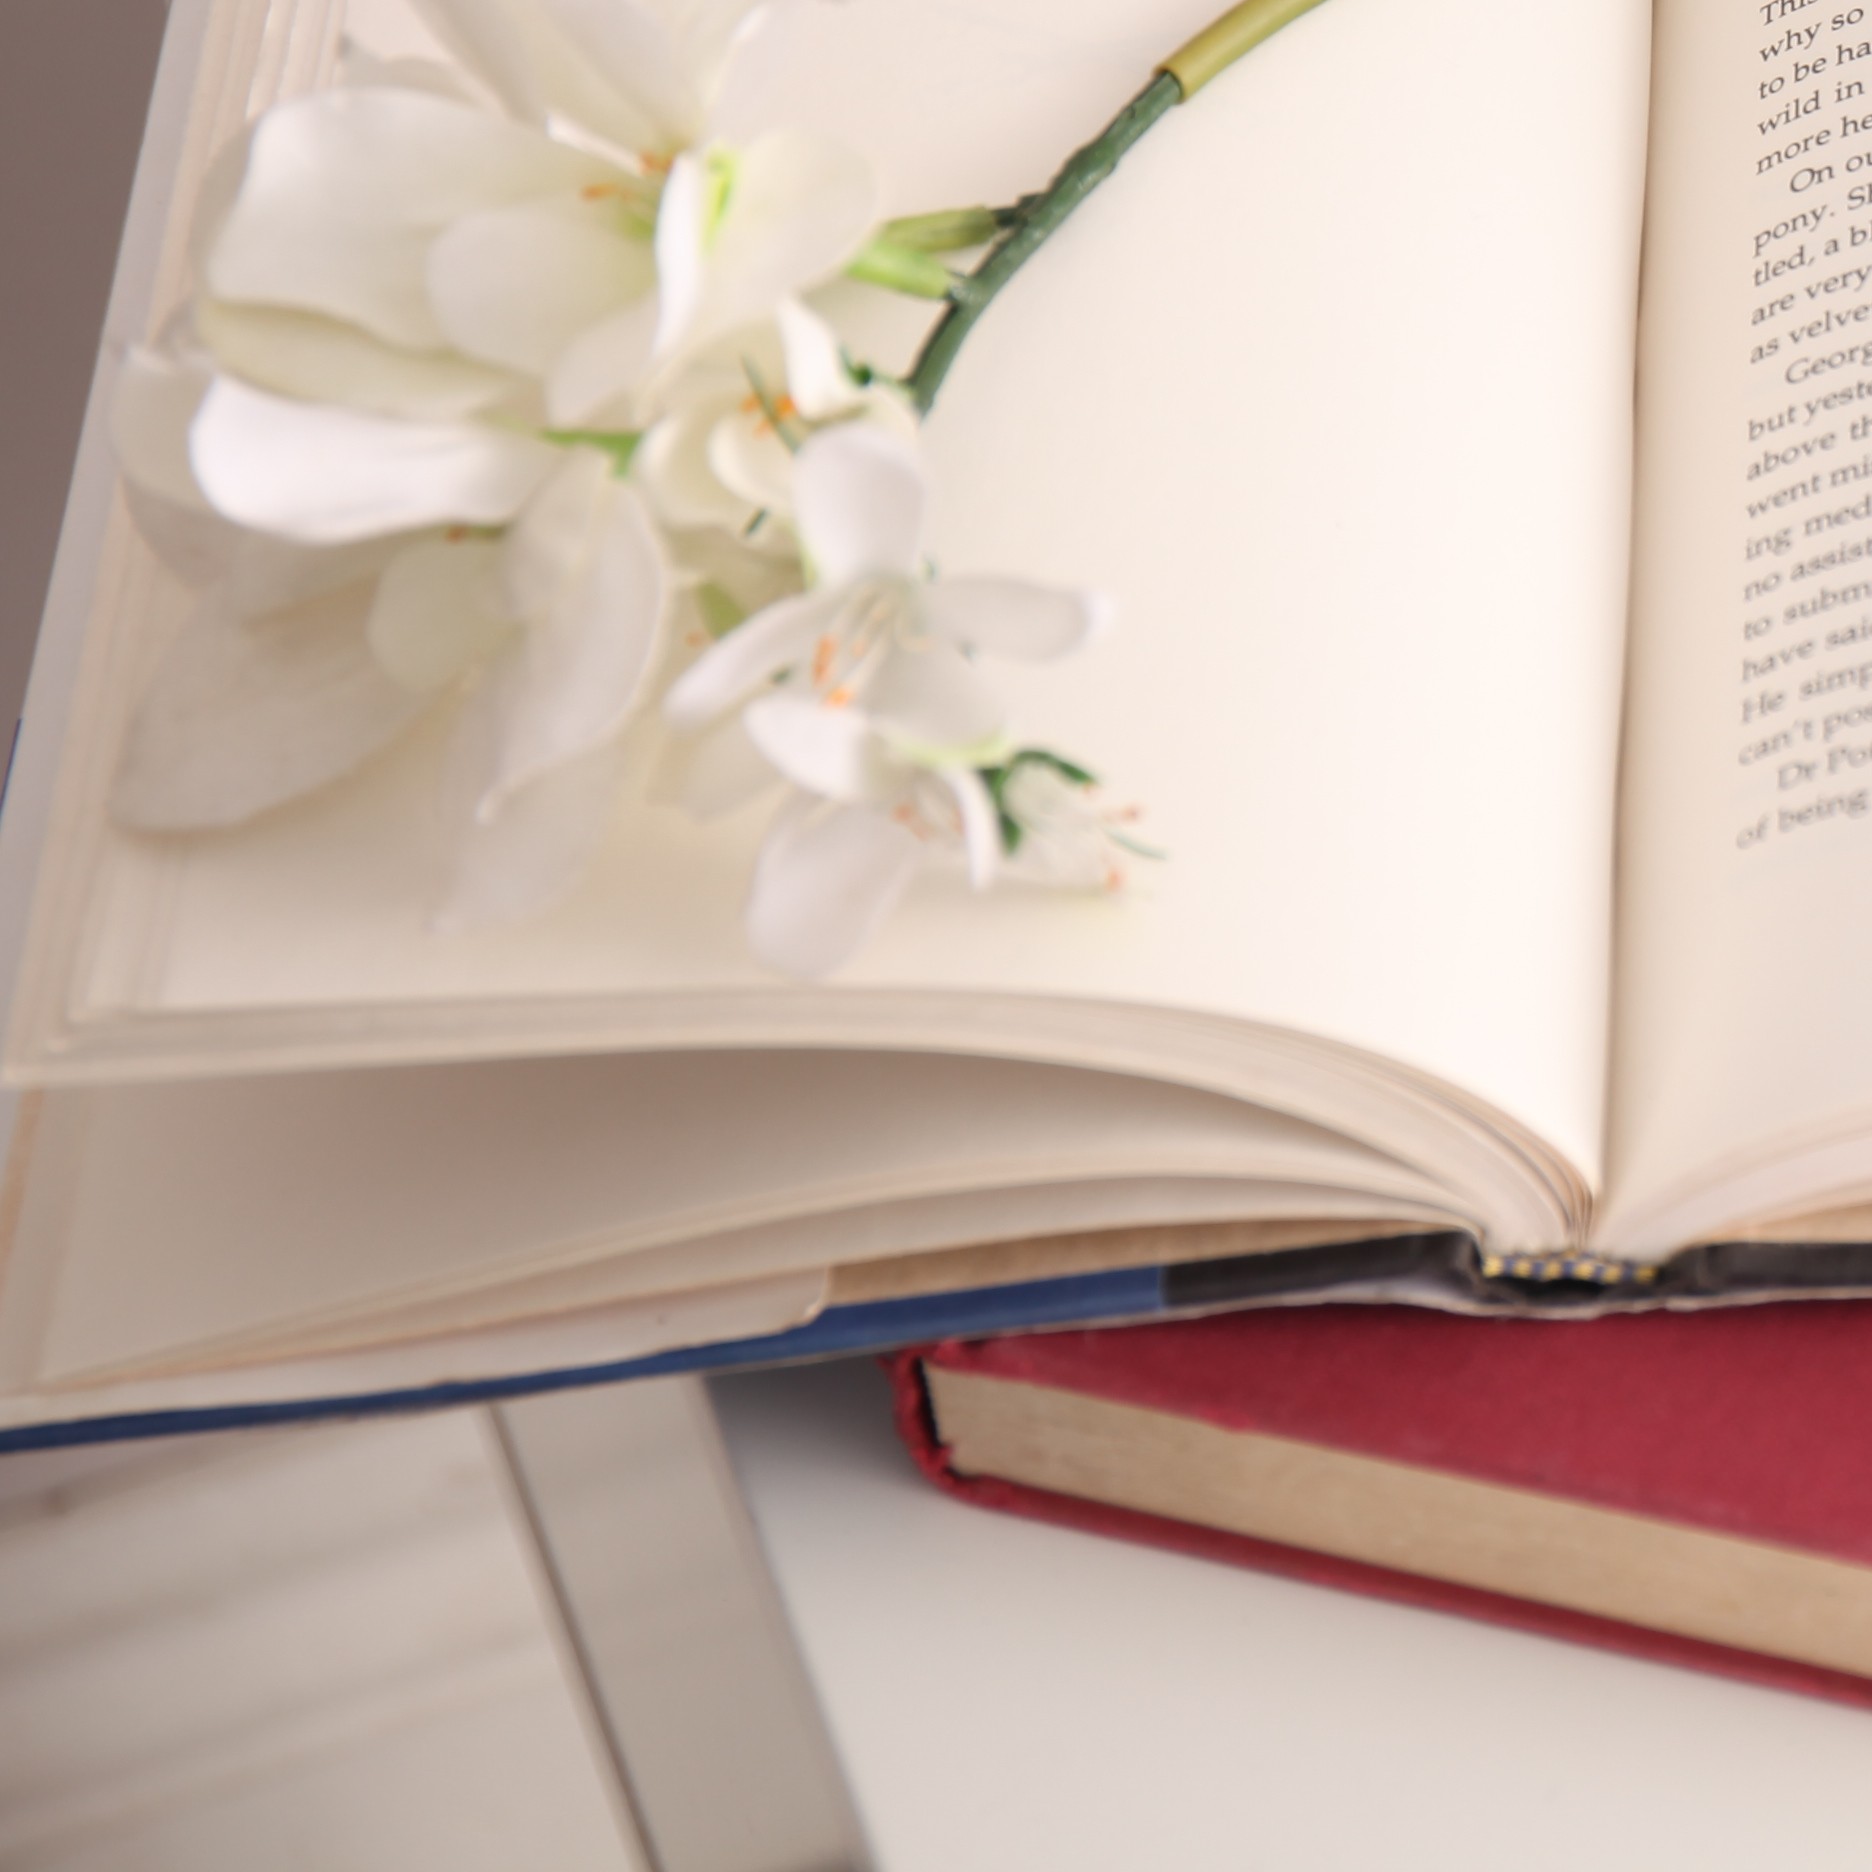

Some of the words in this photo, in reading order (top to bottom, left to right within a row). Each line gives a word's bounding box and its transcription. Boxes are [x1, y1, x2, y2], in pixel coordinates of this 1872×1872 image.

[1759, 22, 1822, 62] why
[1831, 7, 1865, 32] so
[1758, 76, 1786, 100] to
[1792, 57, 1828, 84] be
[1757, 89, 1822, 136] wild
[1835, 80, 1865, 103] in
[1756, 129, 1832, 176] more
[1789, 165, 1835, 194] On
[1753, 204, 1835, 258] pony.
[1753, 244, 1815, 288] tled,
[1823, 238, 1840, 257] a
[1751, 293, 1796, 326] are
[1804, 264, 1872, 300] very
[1749, 337, 1780, 365] as
[1747, 404, 1798, 443] but
[1746, 431, 1837, 482] above
